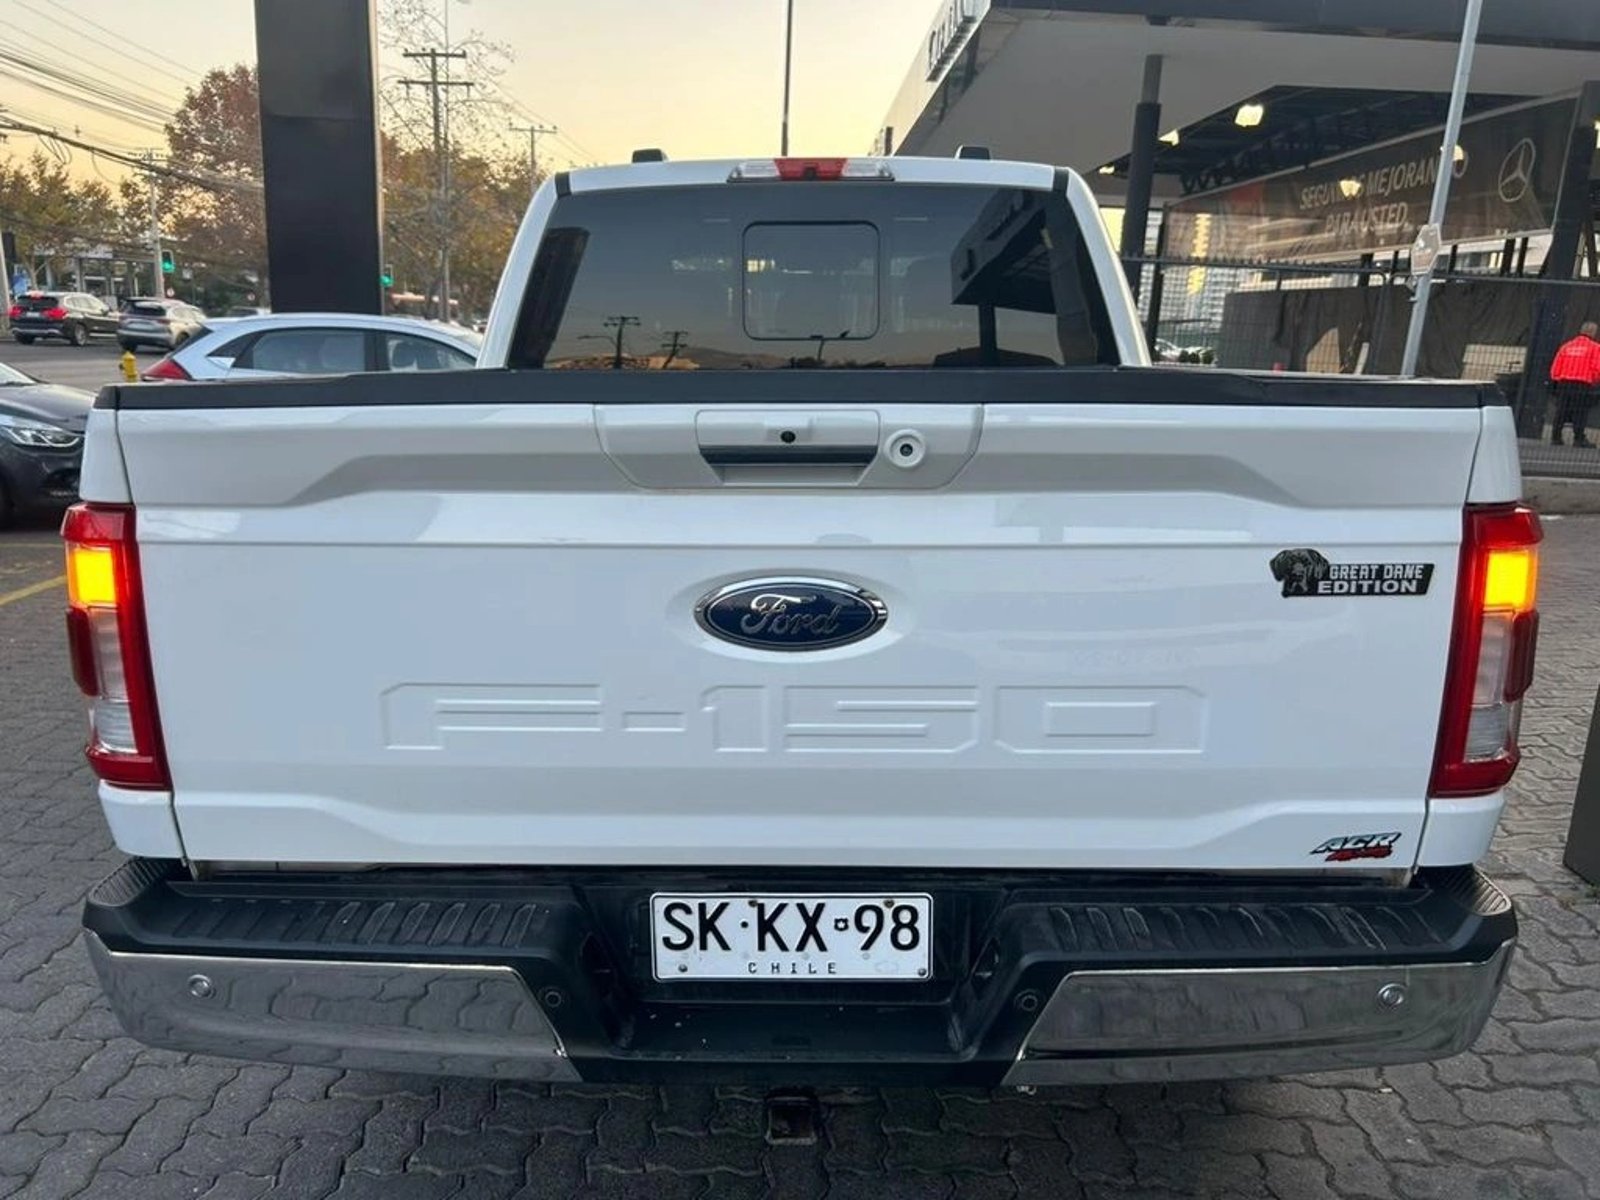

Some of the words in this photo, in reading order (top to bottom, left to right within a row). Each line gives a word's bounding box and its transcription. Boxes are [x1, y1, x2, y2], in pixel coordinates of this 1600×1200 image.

[1367, 151, 1468, 196] MEJORANO
[1329, 565, 1381, 580] GREAT
[1383, 565, 1424, 580] DANE
[1317, 580, 1417, 594] EDITION
[740, 593, 843, 635] Ford
[381, 684, 1208, 753] F-150
[747, 962, 837, 975] CHILE
